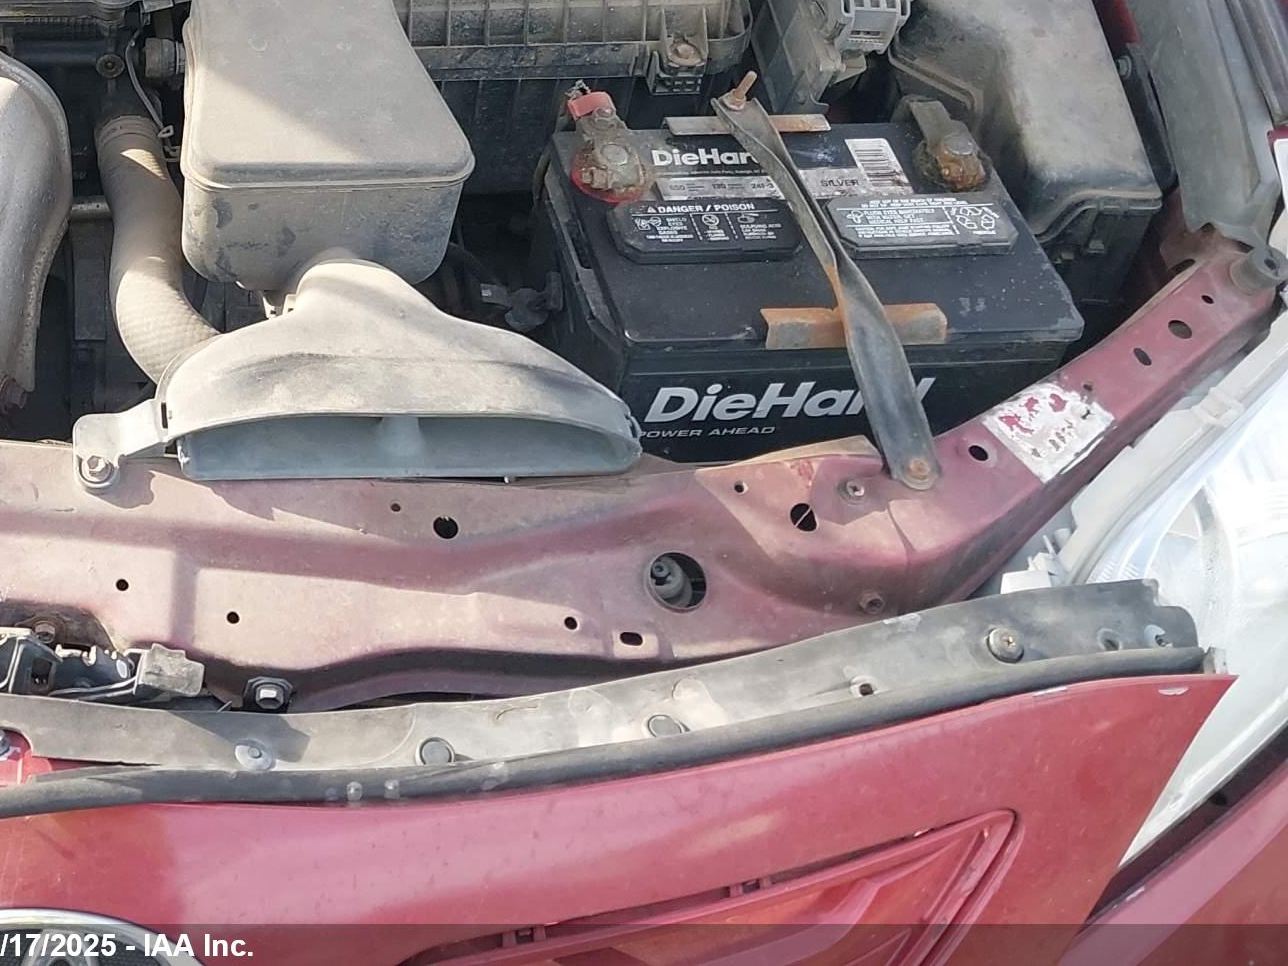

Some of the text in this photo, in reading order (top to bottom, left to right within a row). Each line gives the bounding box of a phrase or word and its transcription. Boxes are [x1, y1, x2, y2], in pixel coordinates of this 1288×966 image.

[652, 148, 760, 166] DieHar
[820, 179, 859, 187] SILVER
[658, 205, 702, 213] DANGER
[714, 202, 755, 211] POISON
[708, 425, 776, 437] AHEAD
